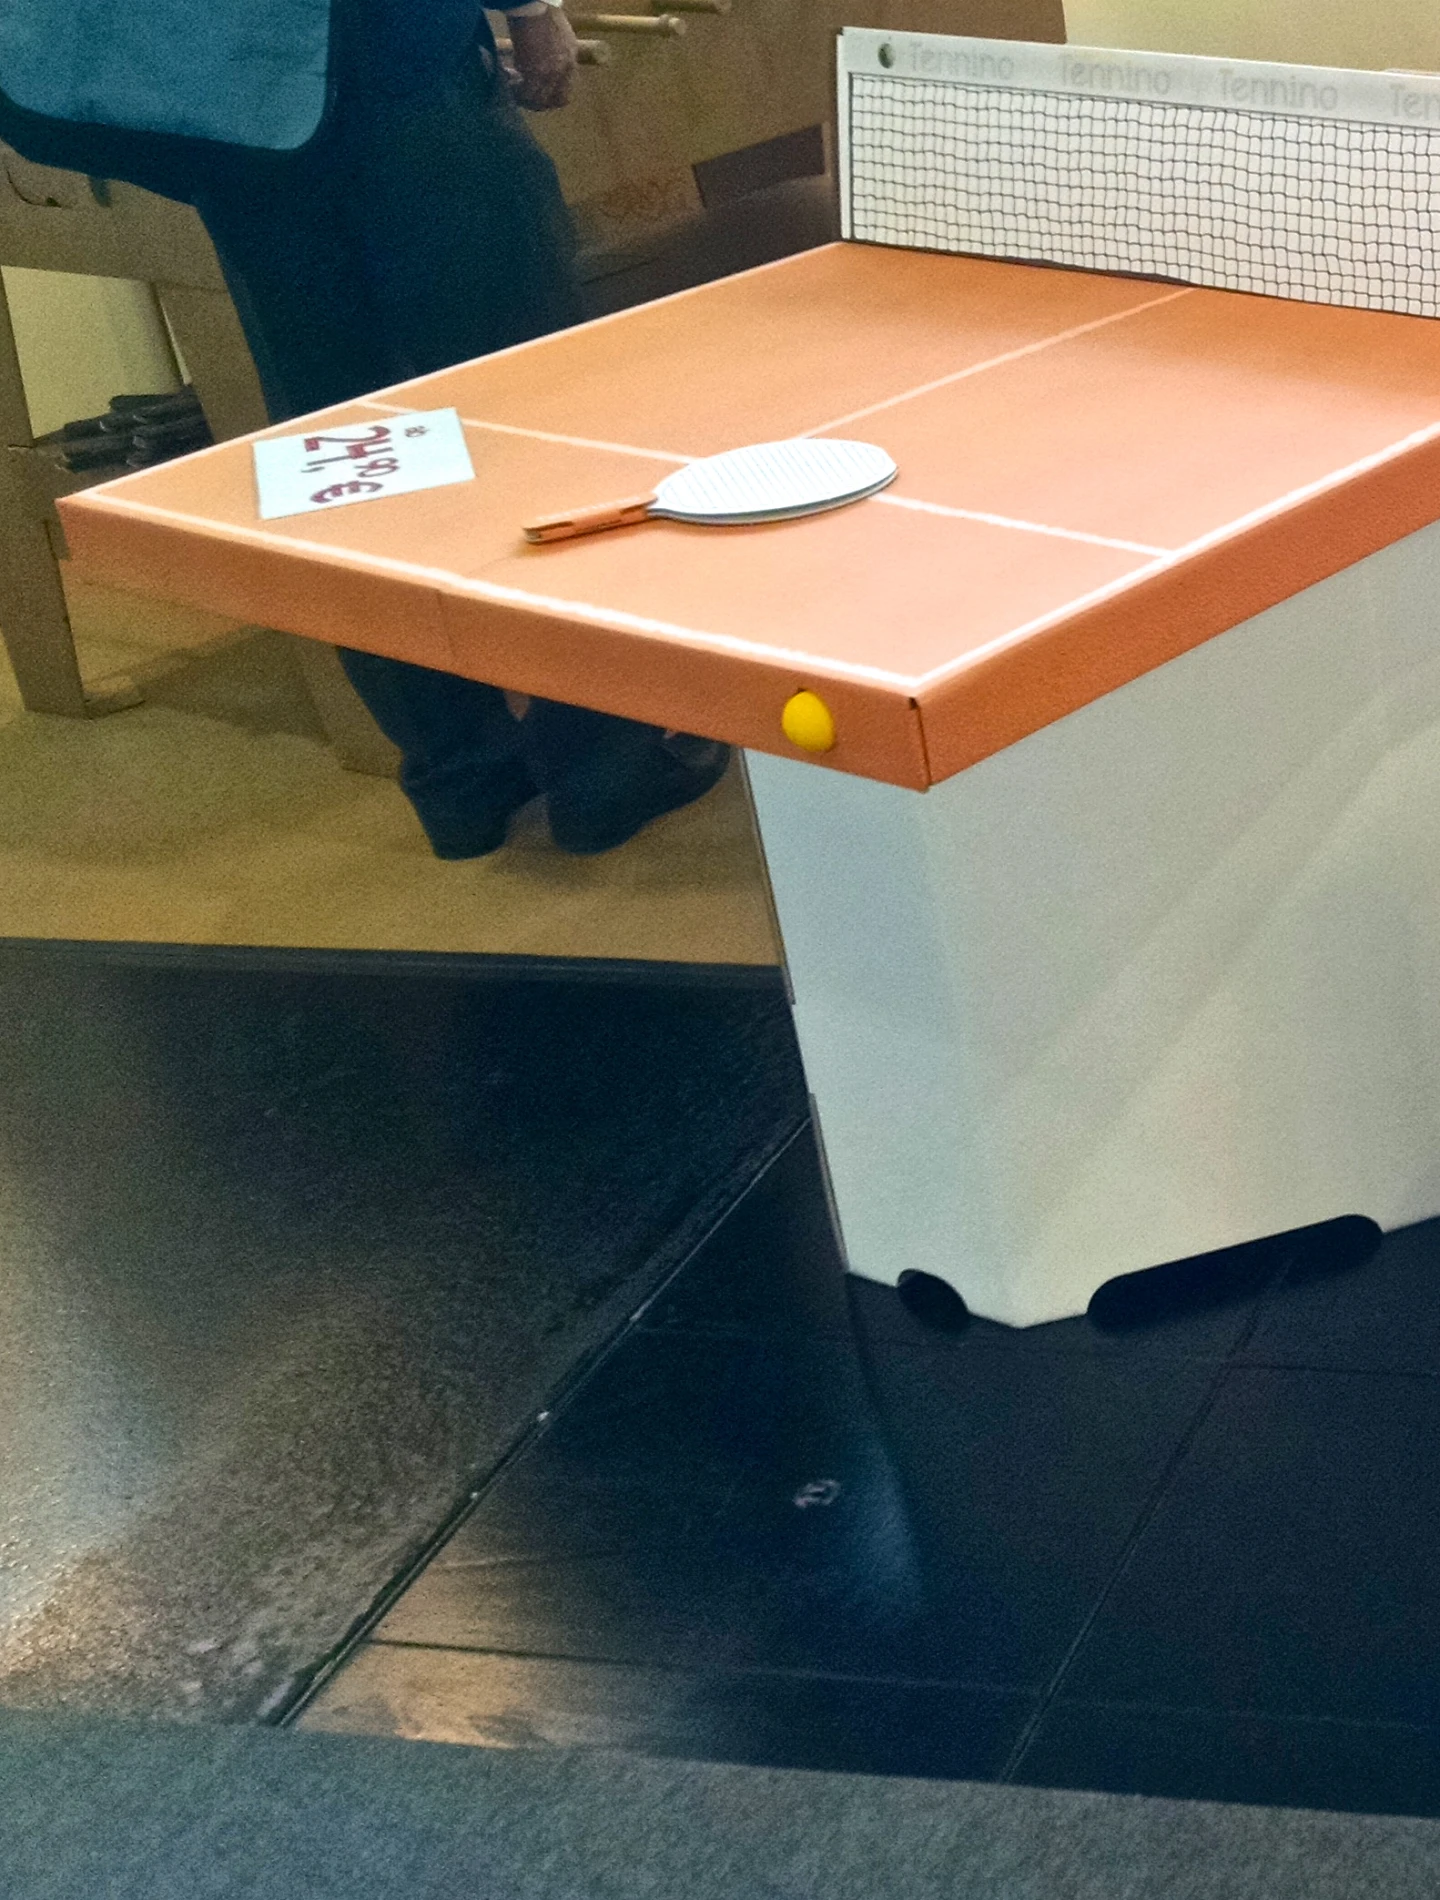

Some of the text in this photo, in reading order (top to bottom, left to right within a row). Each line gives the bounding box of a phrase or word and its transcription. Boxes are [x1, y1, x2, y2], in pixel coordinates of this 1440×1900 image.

[908, 41, 1015, 81] Tennino
[1057, 54, 1172, 95] Tennino
[1218, 68, 1338, 110] Tennino
